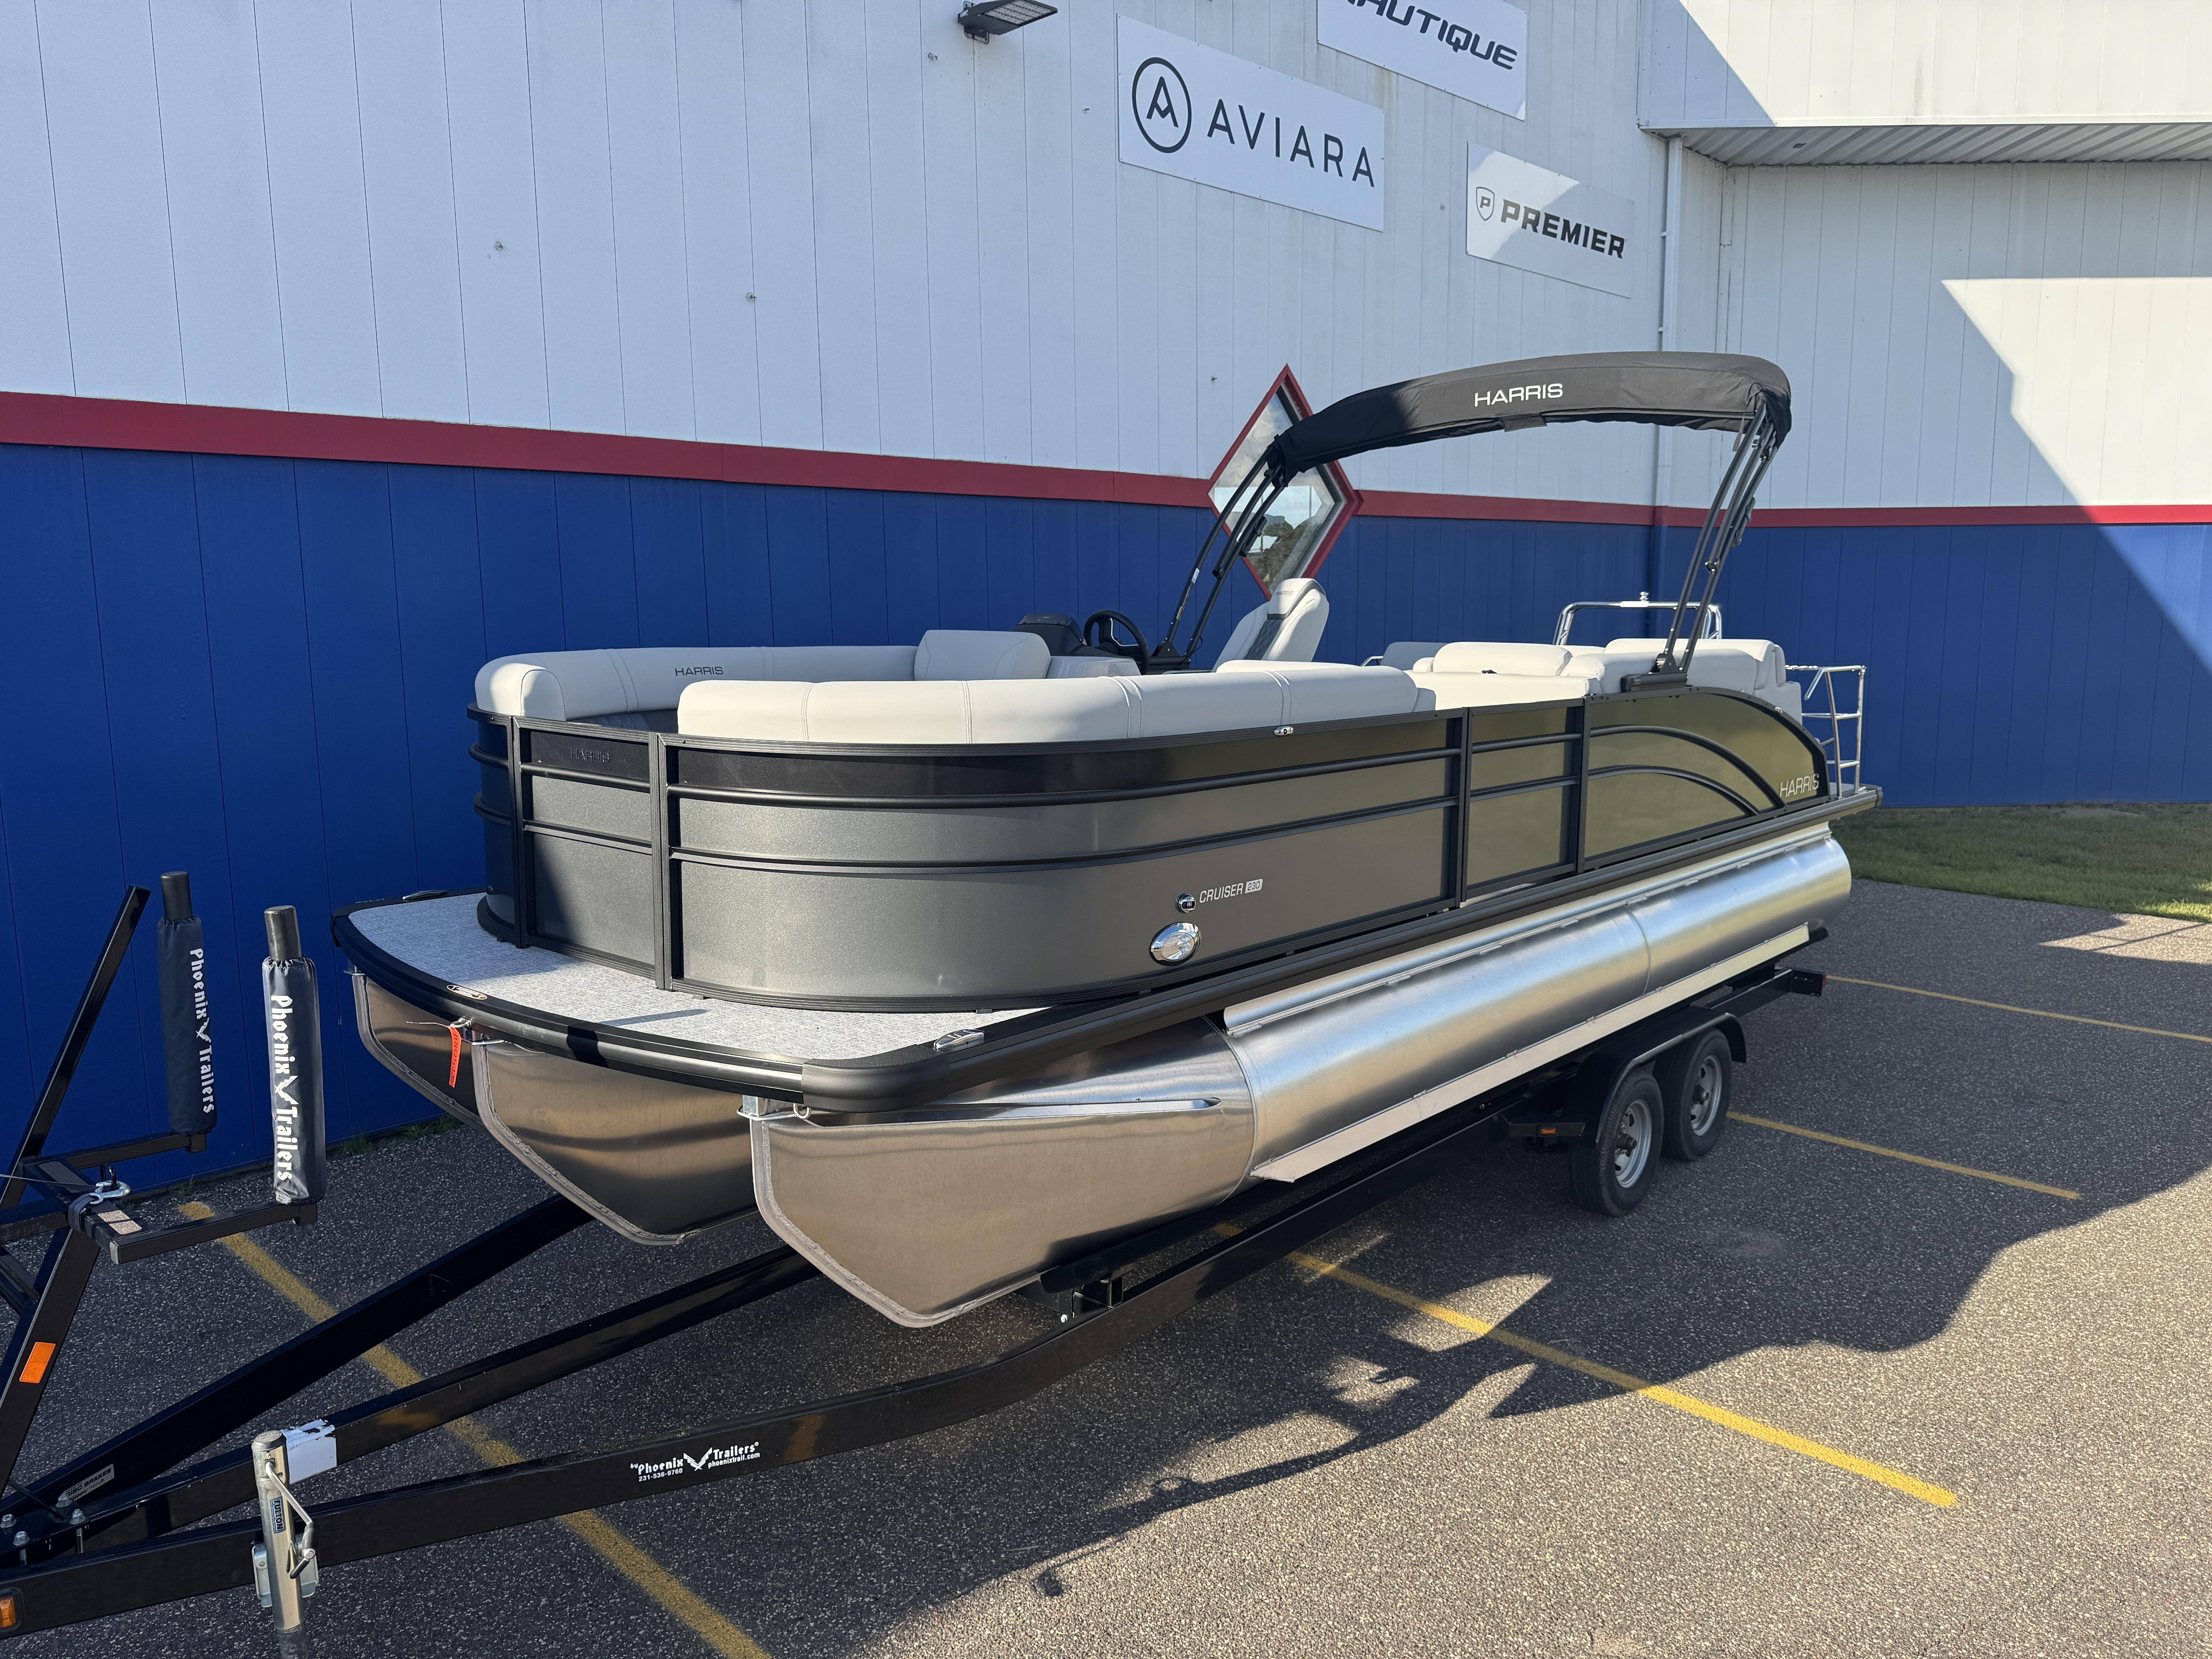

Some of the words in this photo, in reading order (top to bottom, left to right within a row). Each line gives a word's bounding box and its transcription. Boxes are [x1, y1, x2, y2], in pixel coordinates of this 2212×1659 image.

[1207, 99, 1374, 187] AVIARA
[1500, 199, 1625, 259] PREMIER
[1474, 383, 1563, 407] HARRIS
[675, 666, 723, 676] HARRIS
[571, 747, 610, 763] HARRIS
[1780, 773, 1819, 797] HARRIS
[1199, 883, 1243, 903] CRUISER
[1248, 881, 1261, 890] 230
[190, 948, 208, 1020] Phoenix
[199, 1044, 214, 1114] Trailers
[271, 995, 294, 1075] Phoenix
[275, 1106, 298, 1182] Trailers
[84, 1468, 112, 1487] BRAKES
[639, 1468, 683, 1482] 231-536-9760
[273, 1499, 284, 1530] FULTON
